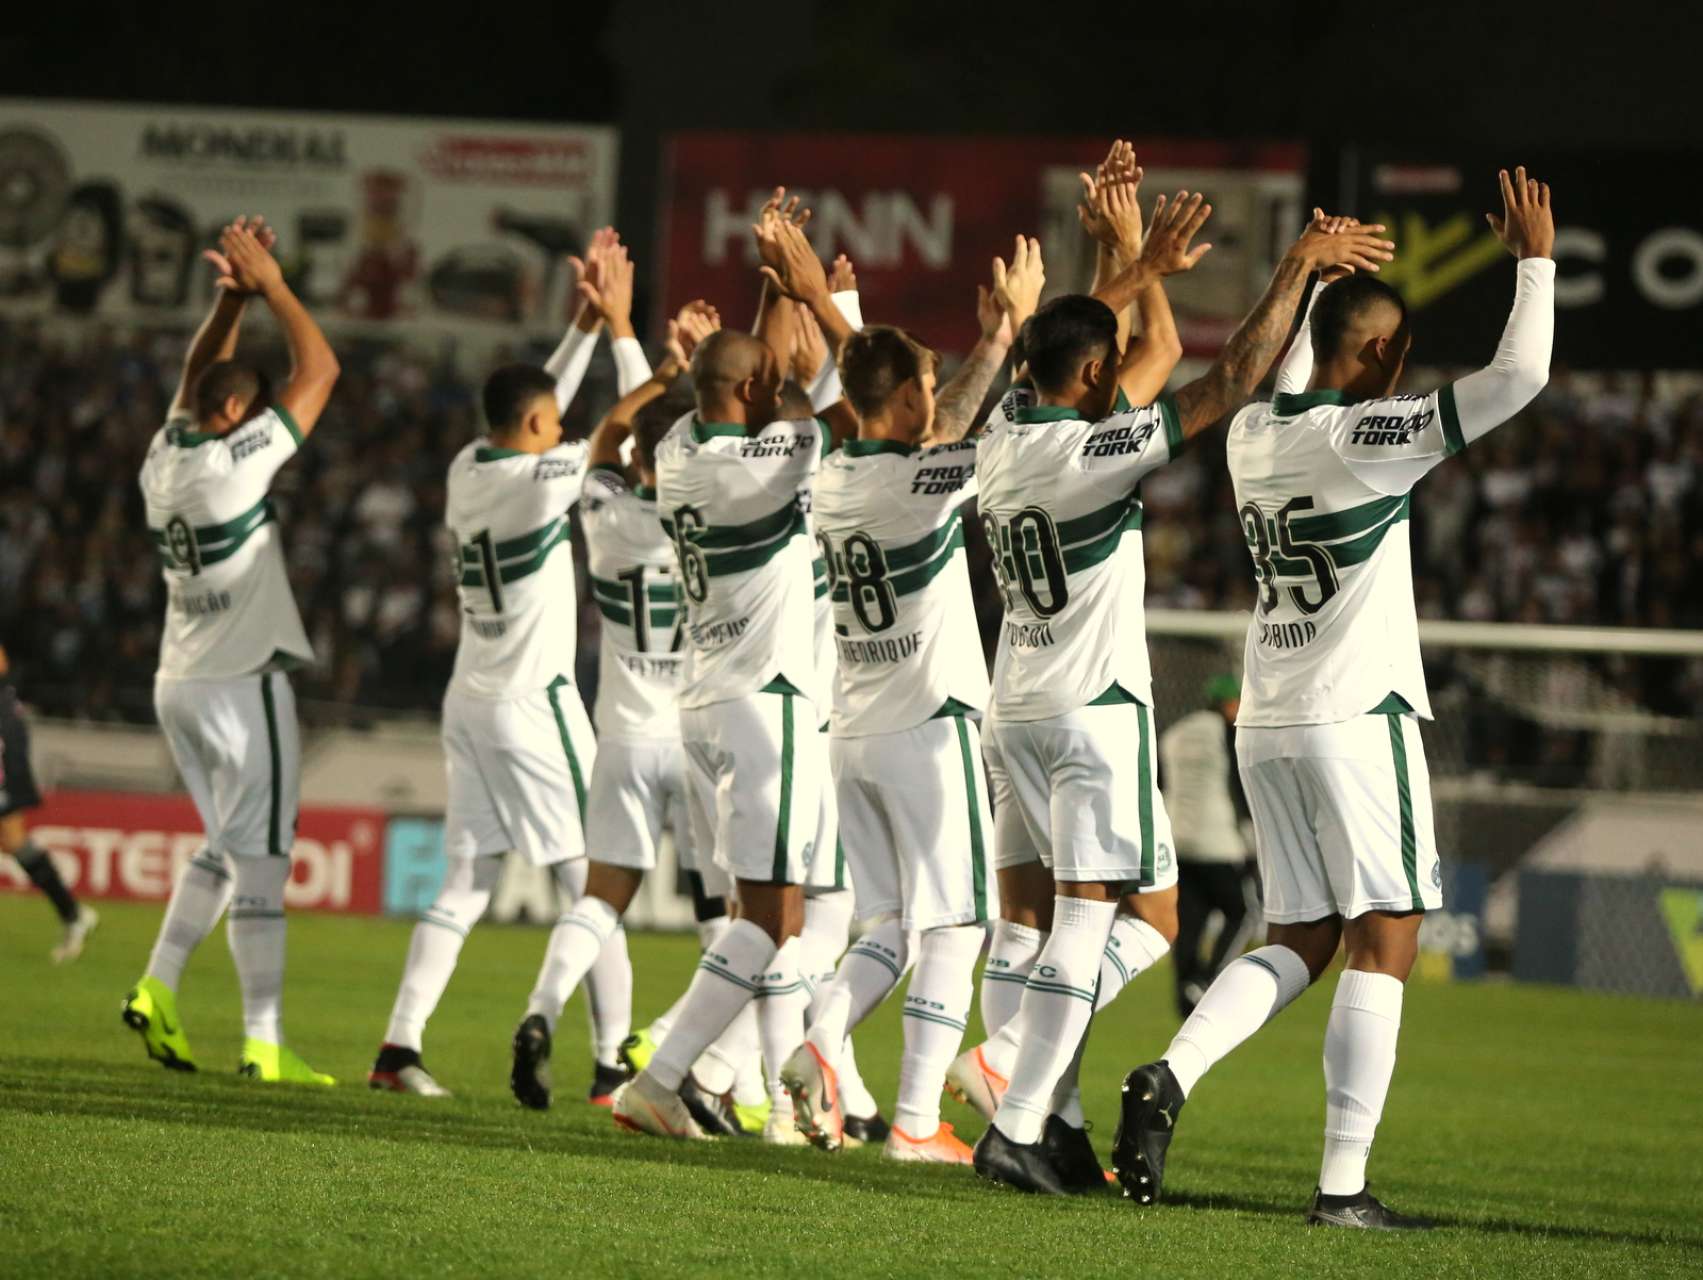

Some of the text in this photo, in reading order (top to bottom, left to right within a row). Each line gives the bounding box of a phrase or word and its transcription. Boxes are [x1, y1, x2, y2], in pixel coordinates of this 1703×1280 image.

[704, 190, 952, 268] HNN
[1355, 416, 1404, 430] PRO
[1086, 428, 1132, 444] PRO
[1351, 431, 1411, 446] TORK
[1082, 439, 1141, 457] TORK
[915, 465, 963, 480] PRO
[1240, 495, 1340, 616] 35
